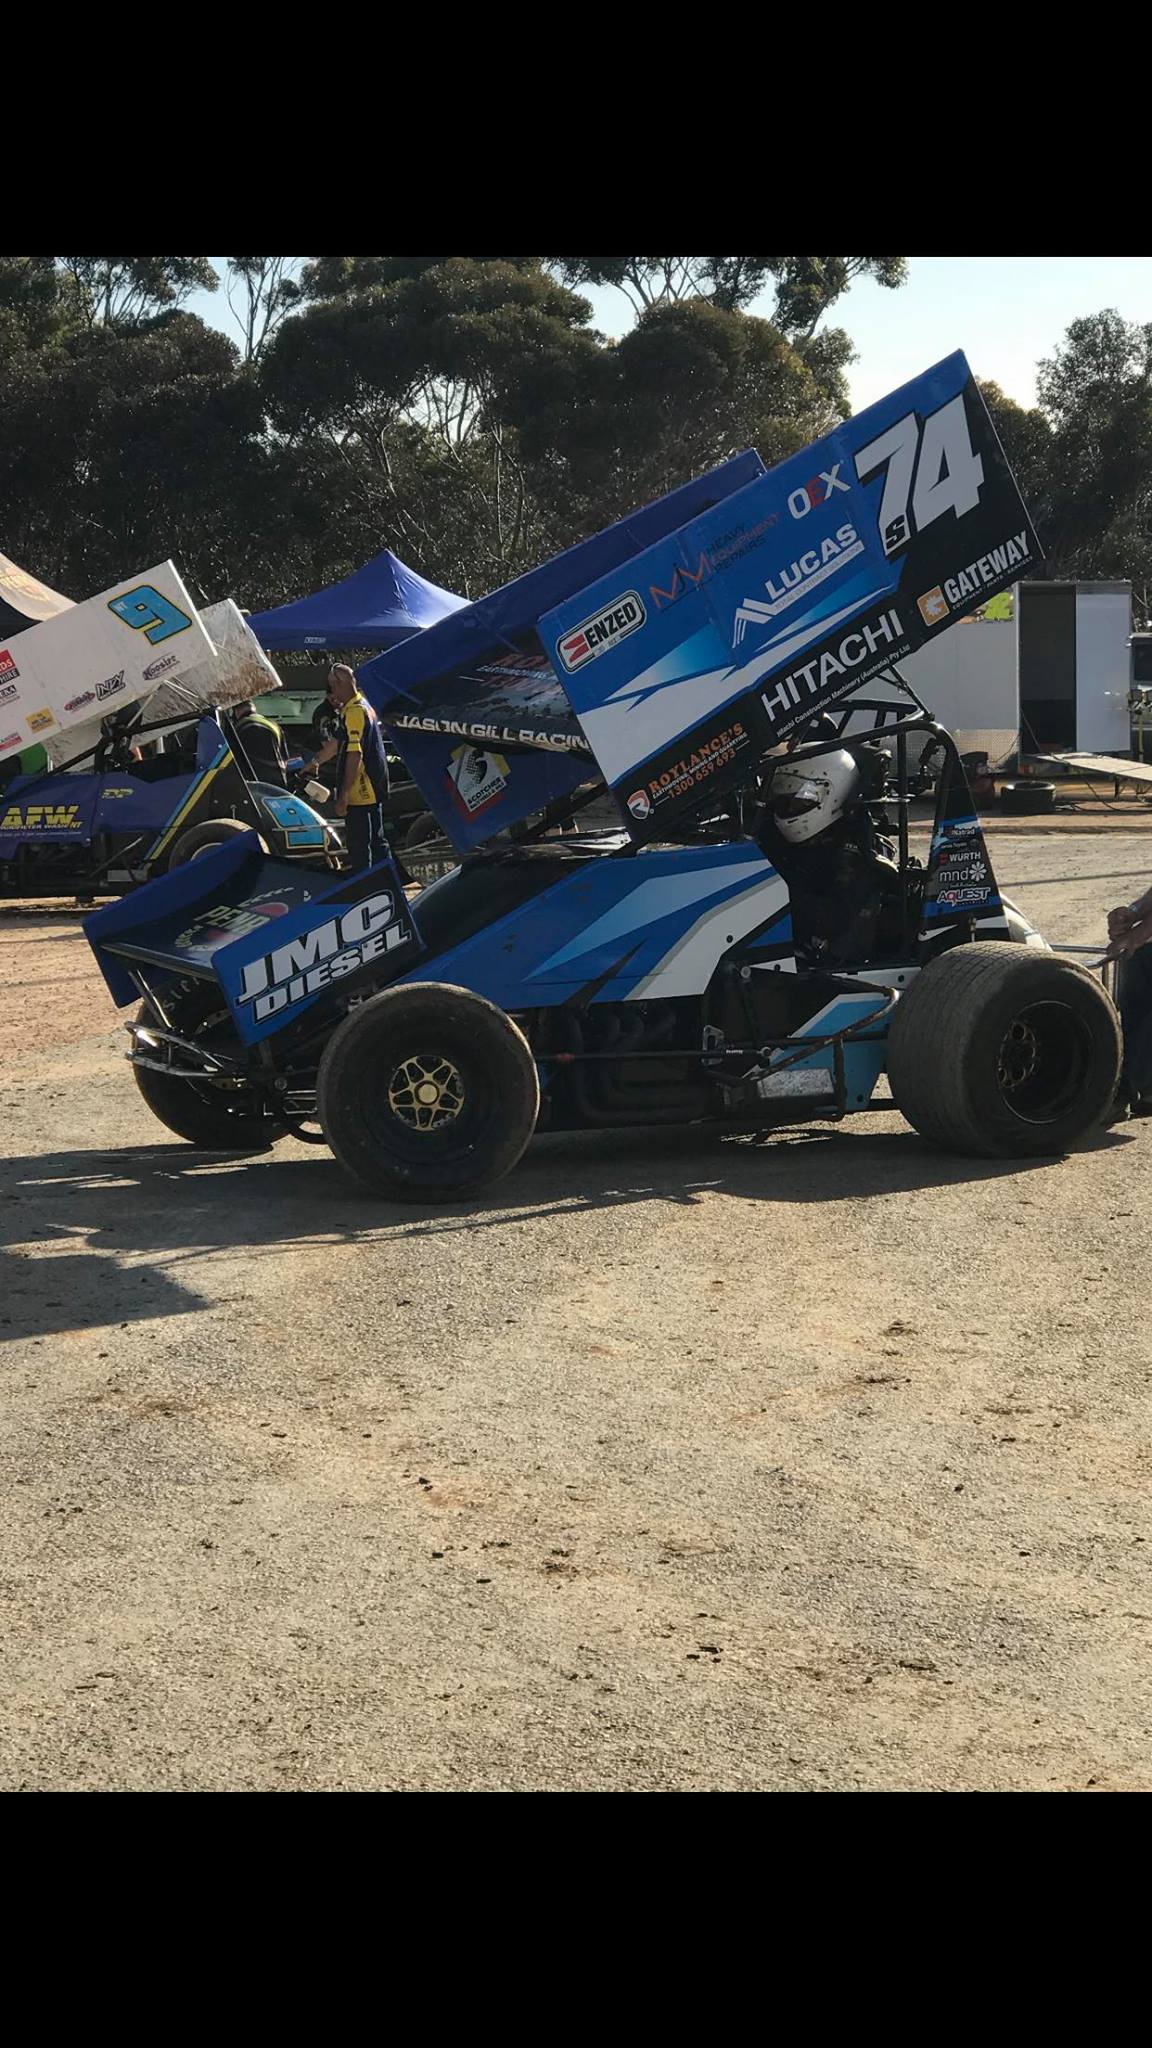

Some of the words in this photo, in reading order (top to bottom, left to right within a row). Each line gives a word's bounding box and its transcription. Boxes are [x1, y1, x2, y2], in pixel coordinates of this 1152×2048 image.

[788, 463, 851, 519] OEX
[855, 393, 984, 556] 74
[886, 514, 905, 549] S
[765, 523, 857, 600] LUCAS
[944, 530, 1030, 603] GATEWAY
[108, 585, 192, 645] 9
[584, 602, 637, 649] ENZED
[761, 609, 904, 721] HITACHI
[777, 719, 795, 737] Hitachi
[795, 696, 832, 723] Construction
[832, 676, 861, 699] Machinery
[861, 656, 890, 681] (Australia)
[890, 649, 900, 664] Pty
[898, 644, 910, 656] Ltd
[396, 715, 467, 736] JASON
[648, 722, 743, 793] ROYLANCE'S
[669, 776, 695, 799] 1300
[695, 762, 715, 781] 659
[716, 748, 736, 767] 693
[688, 758, 708, 774] MINING
[707, 750, 719, 762] AND
[1, 805, 80, 827] AFW
[937, 887, 991, 907] AQUEST
[940, 867, 969, 882] mnd
[238, 893, 394, 1004] JMC
[254, 924, 410, 1020] DIESEL
